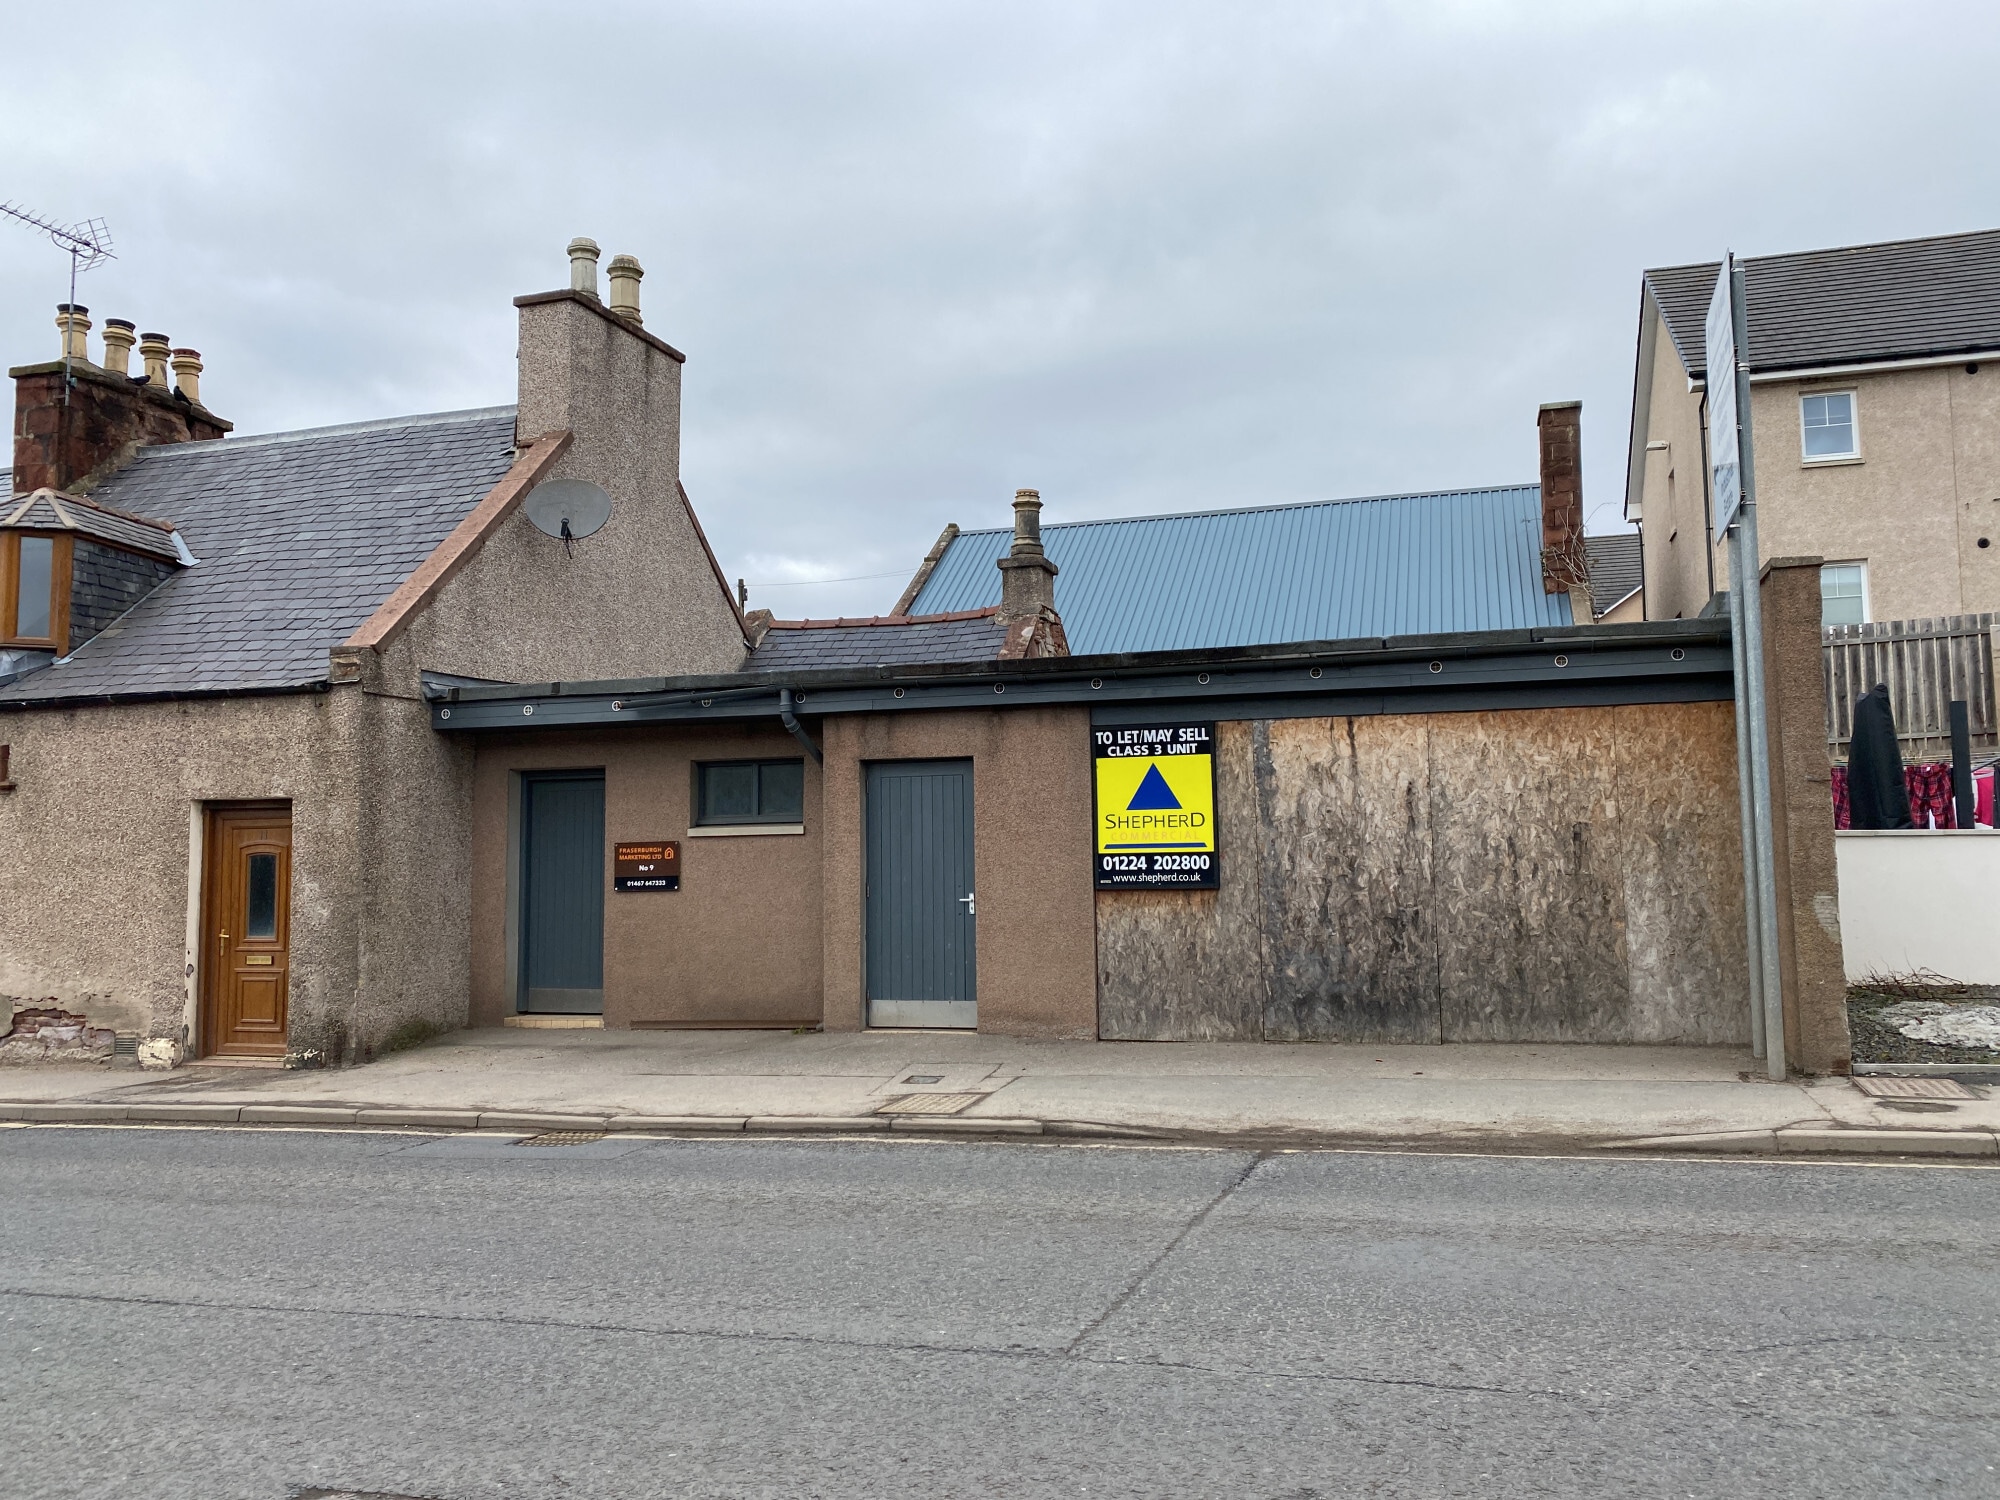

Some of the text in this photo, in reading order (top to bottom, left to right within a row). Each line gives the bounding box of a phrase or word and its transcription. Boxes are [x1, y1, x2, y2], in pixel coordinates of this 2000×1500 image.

[1096, 727, 1210, 745] TO LET/MAY SELL
[1107, 743, 1198, 757] CLASS 3 UNIT
[1111, 831, 1200, 841] COMMERCIAL
[1102, 854, 1210, 871] 01224 202800
[1112, 872, 1201, 884] www.shepherd.co.uk
